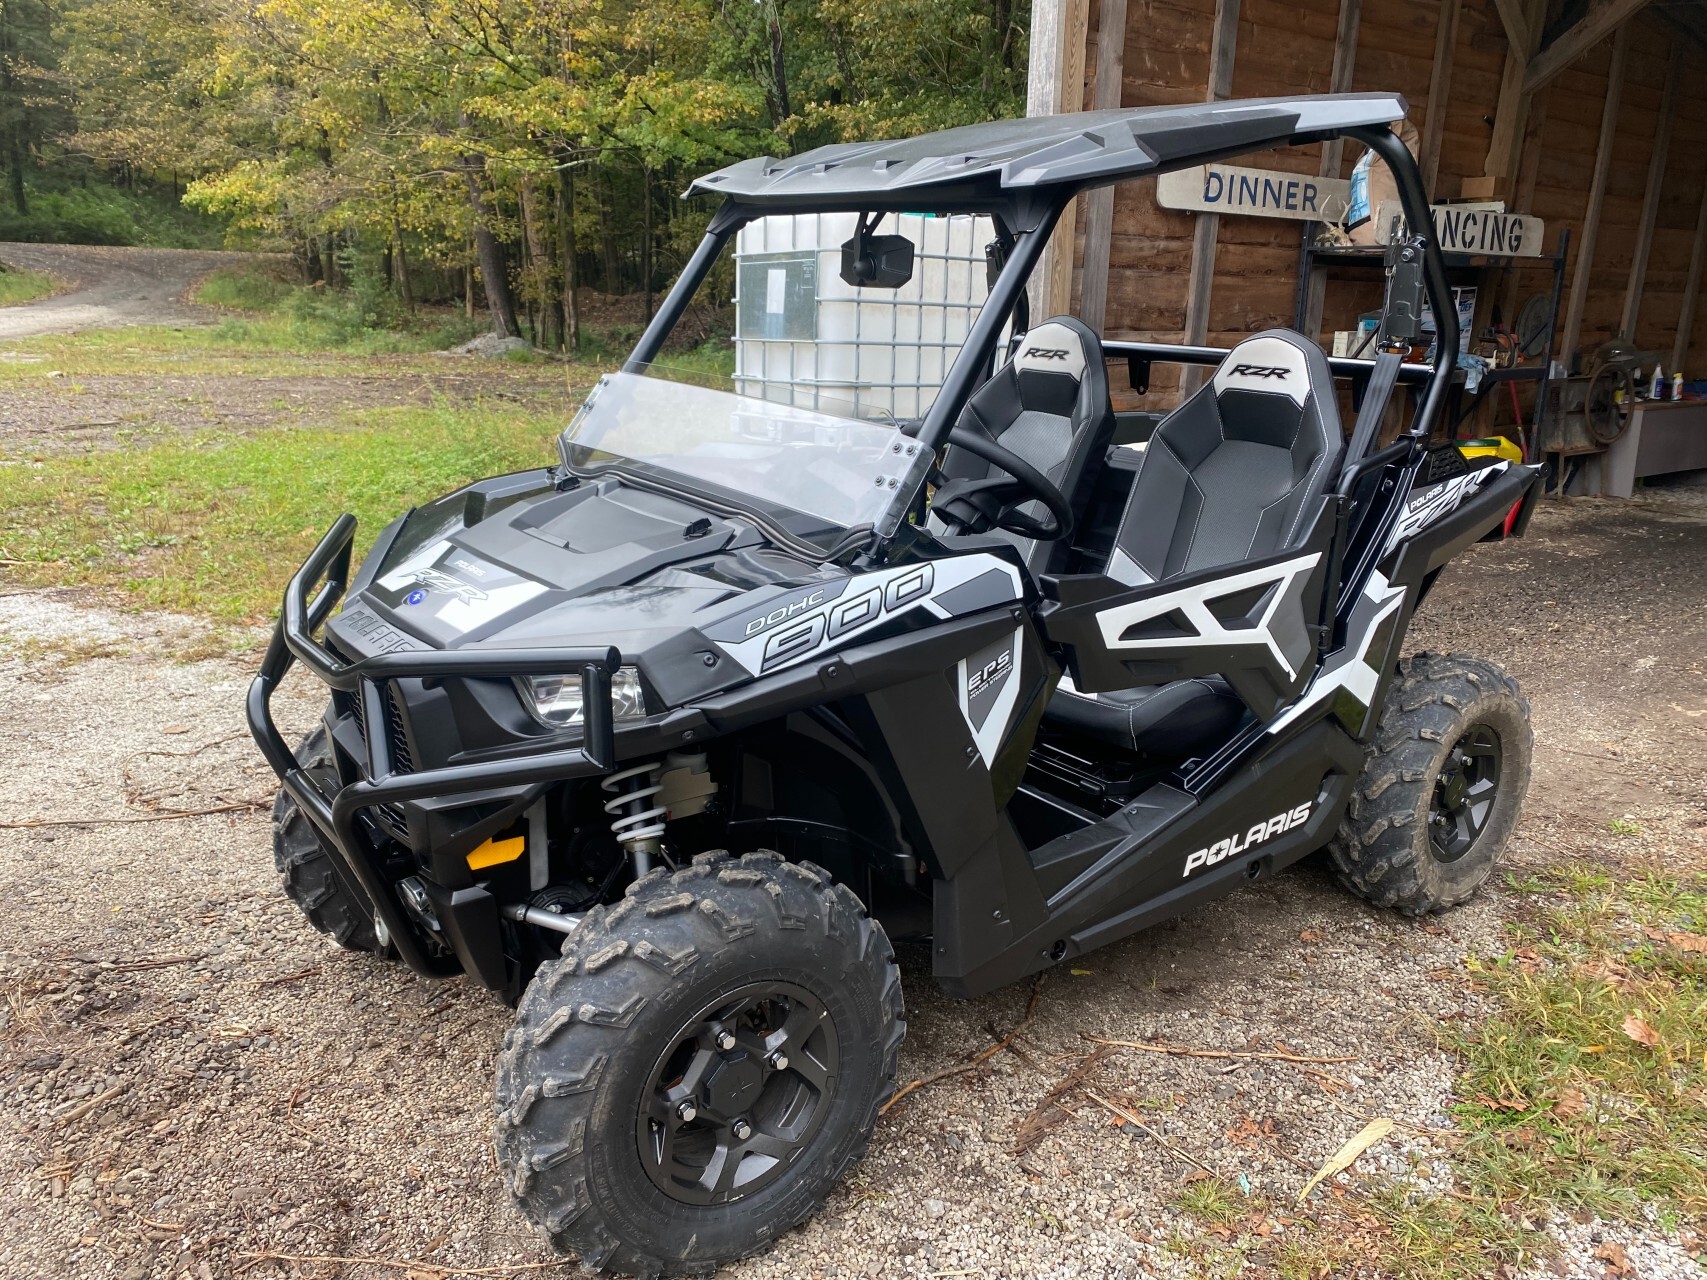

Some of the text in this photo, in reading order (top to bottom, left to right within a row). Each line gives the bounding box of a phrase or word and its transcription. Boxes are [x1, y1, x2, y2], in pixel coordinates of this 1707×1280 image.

[1204, 172, 1317, 212] DINNER
[1023, 347, 1070, 361] RZR
[1227, 364, 1292, 381] RZR
[1384, 468, 1481, 557] RZR
[1410, 484, 1443, 511] POLARIS
[397, 567, 489, 606] RZR
[453, 559, 487, 577] POLARIS
[745, 589, 824, 636] DOHC
[760, 562, 935, 674] 900
[968, 649, 1010, 691] EPS
[1182, 800, 1312, 878] POLARIS
